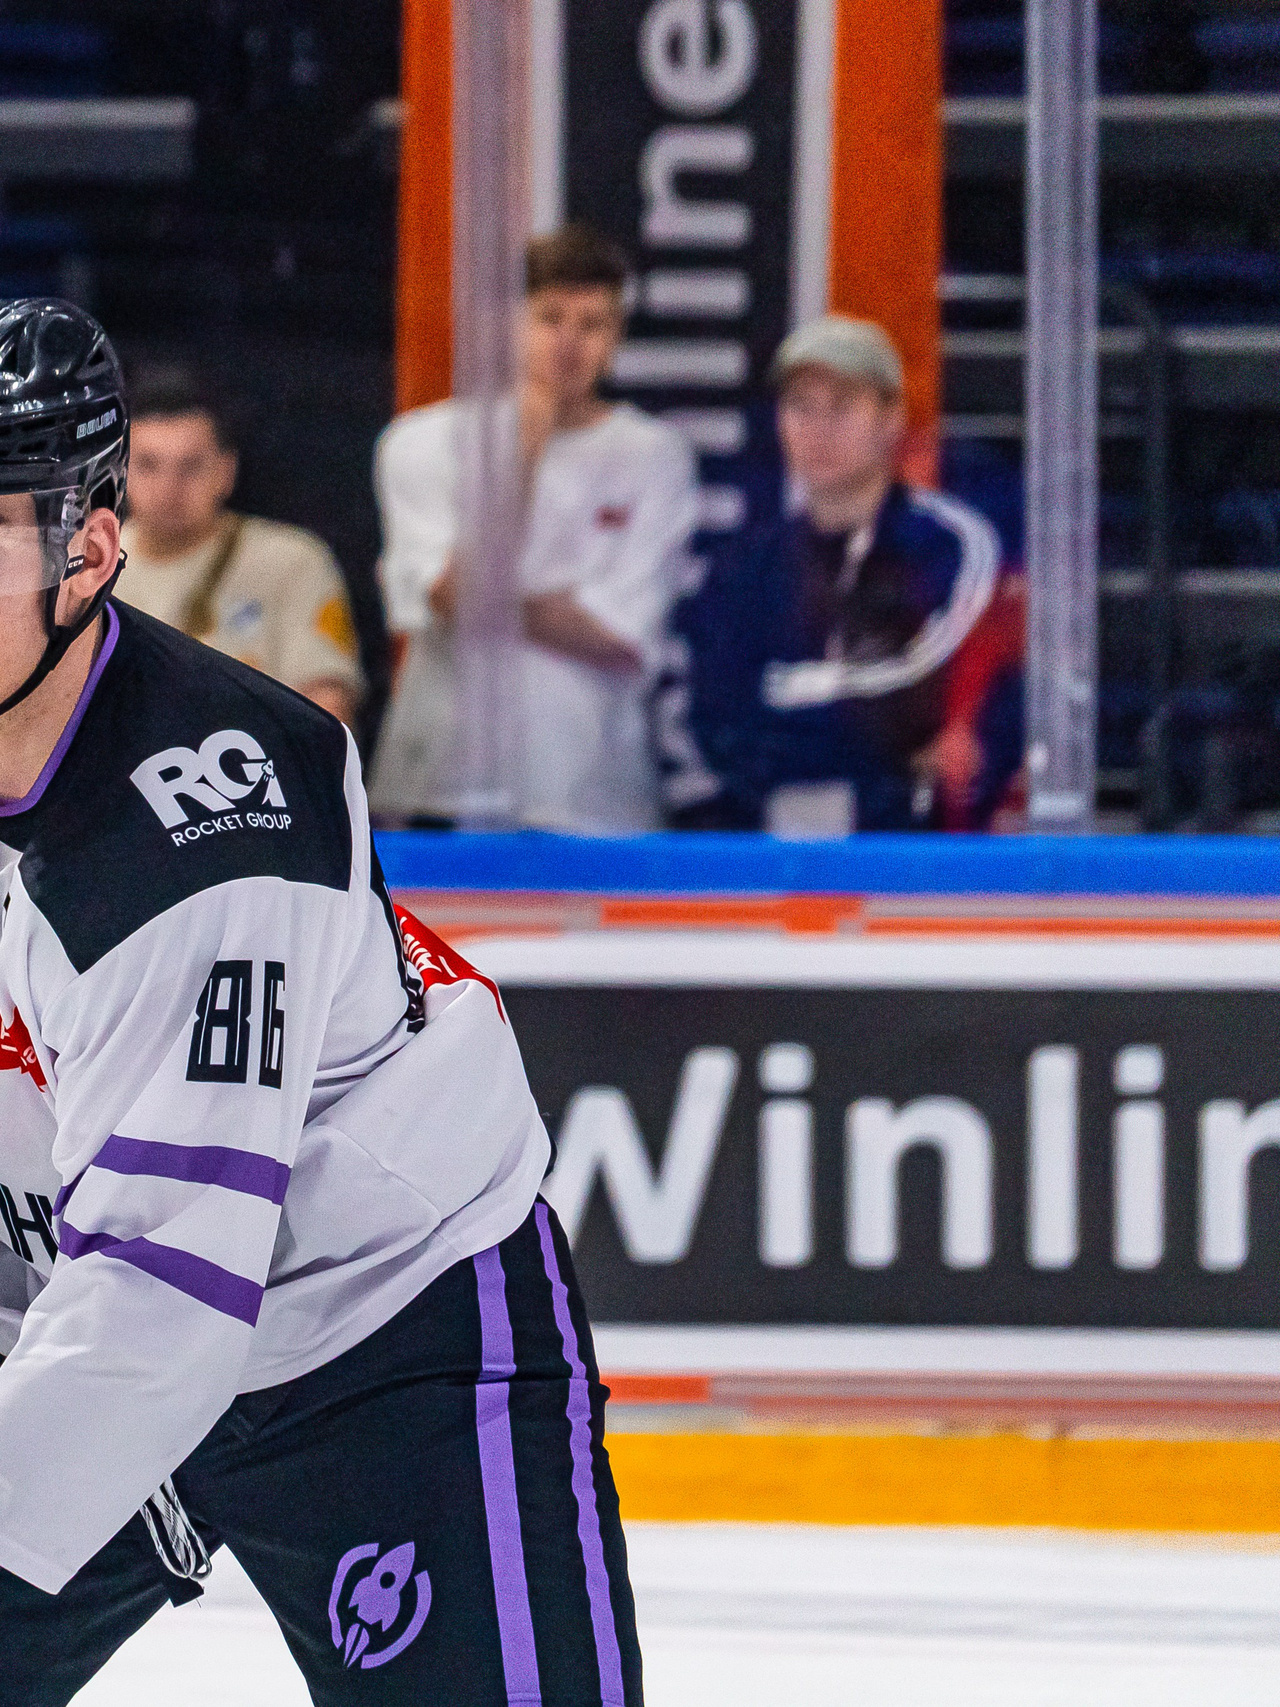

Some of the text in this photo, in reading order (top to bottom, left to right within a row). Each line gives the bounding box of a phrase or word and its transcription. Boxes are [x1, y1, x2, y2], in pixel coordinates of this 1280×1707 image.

[171, 812, 292, 847] ROCKET GROUP
[185, 959, 286, 1091] 86
